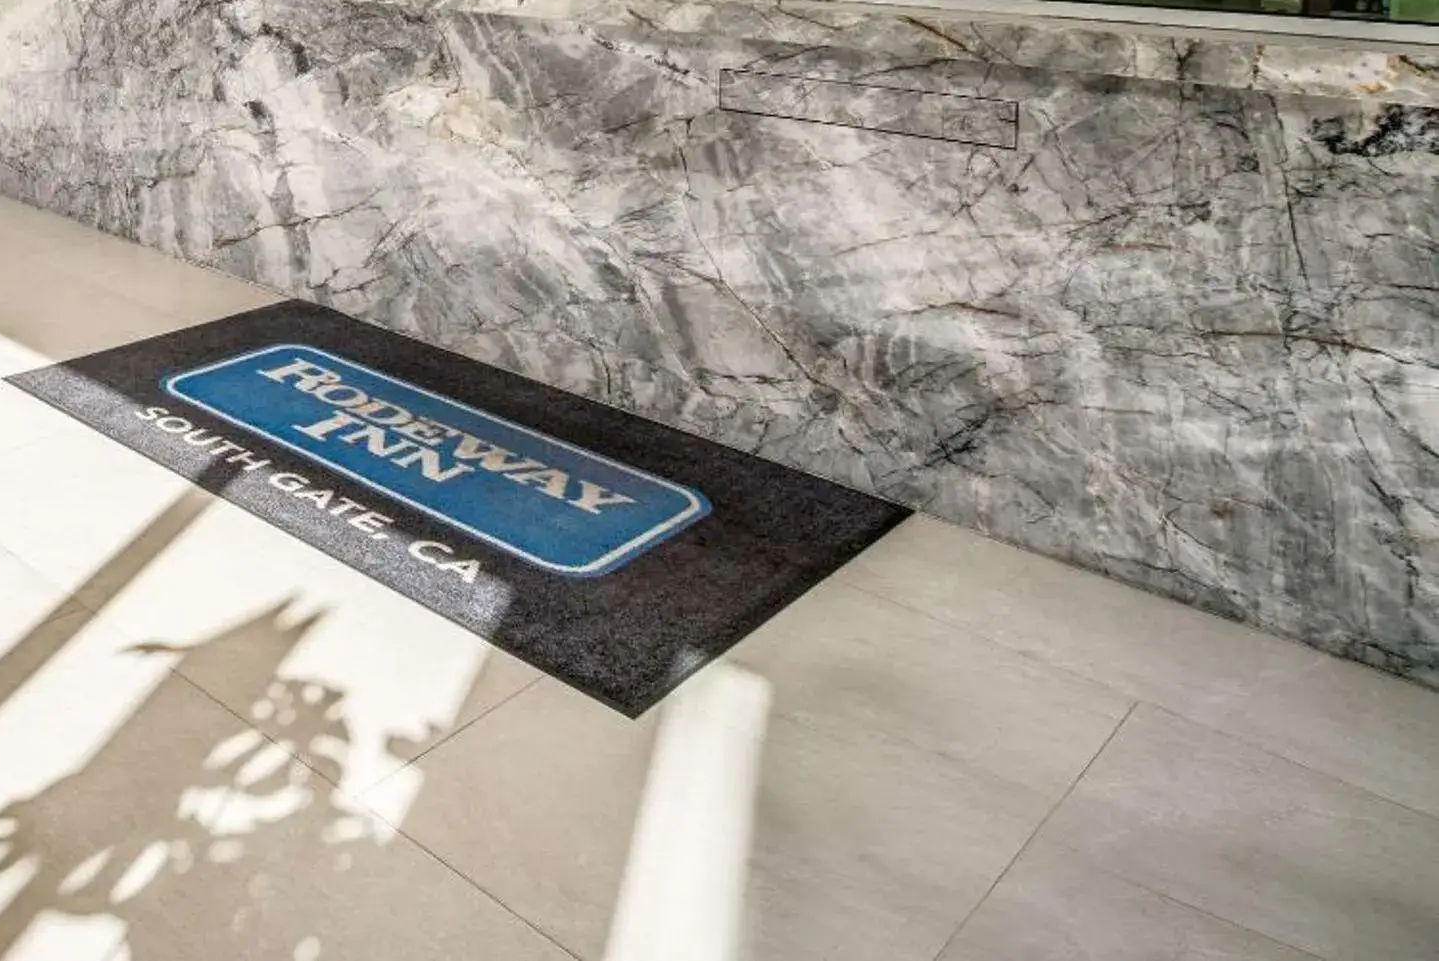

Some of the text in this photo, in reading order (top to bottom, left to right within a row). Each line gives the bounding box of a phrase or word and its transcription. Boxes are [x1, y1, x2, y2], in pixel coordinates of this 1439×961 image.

[134, 406, 481, 585] SOUTH GATE, CA
[255, 357, 637, 515] RODEWAY
[292, 409, 476, 483] INN
